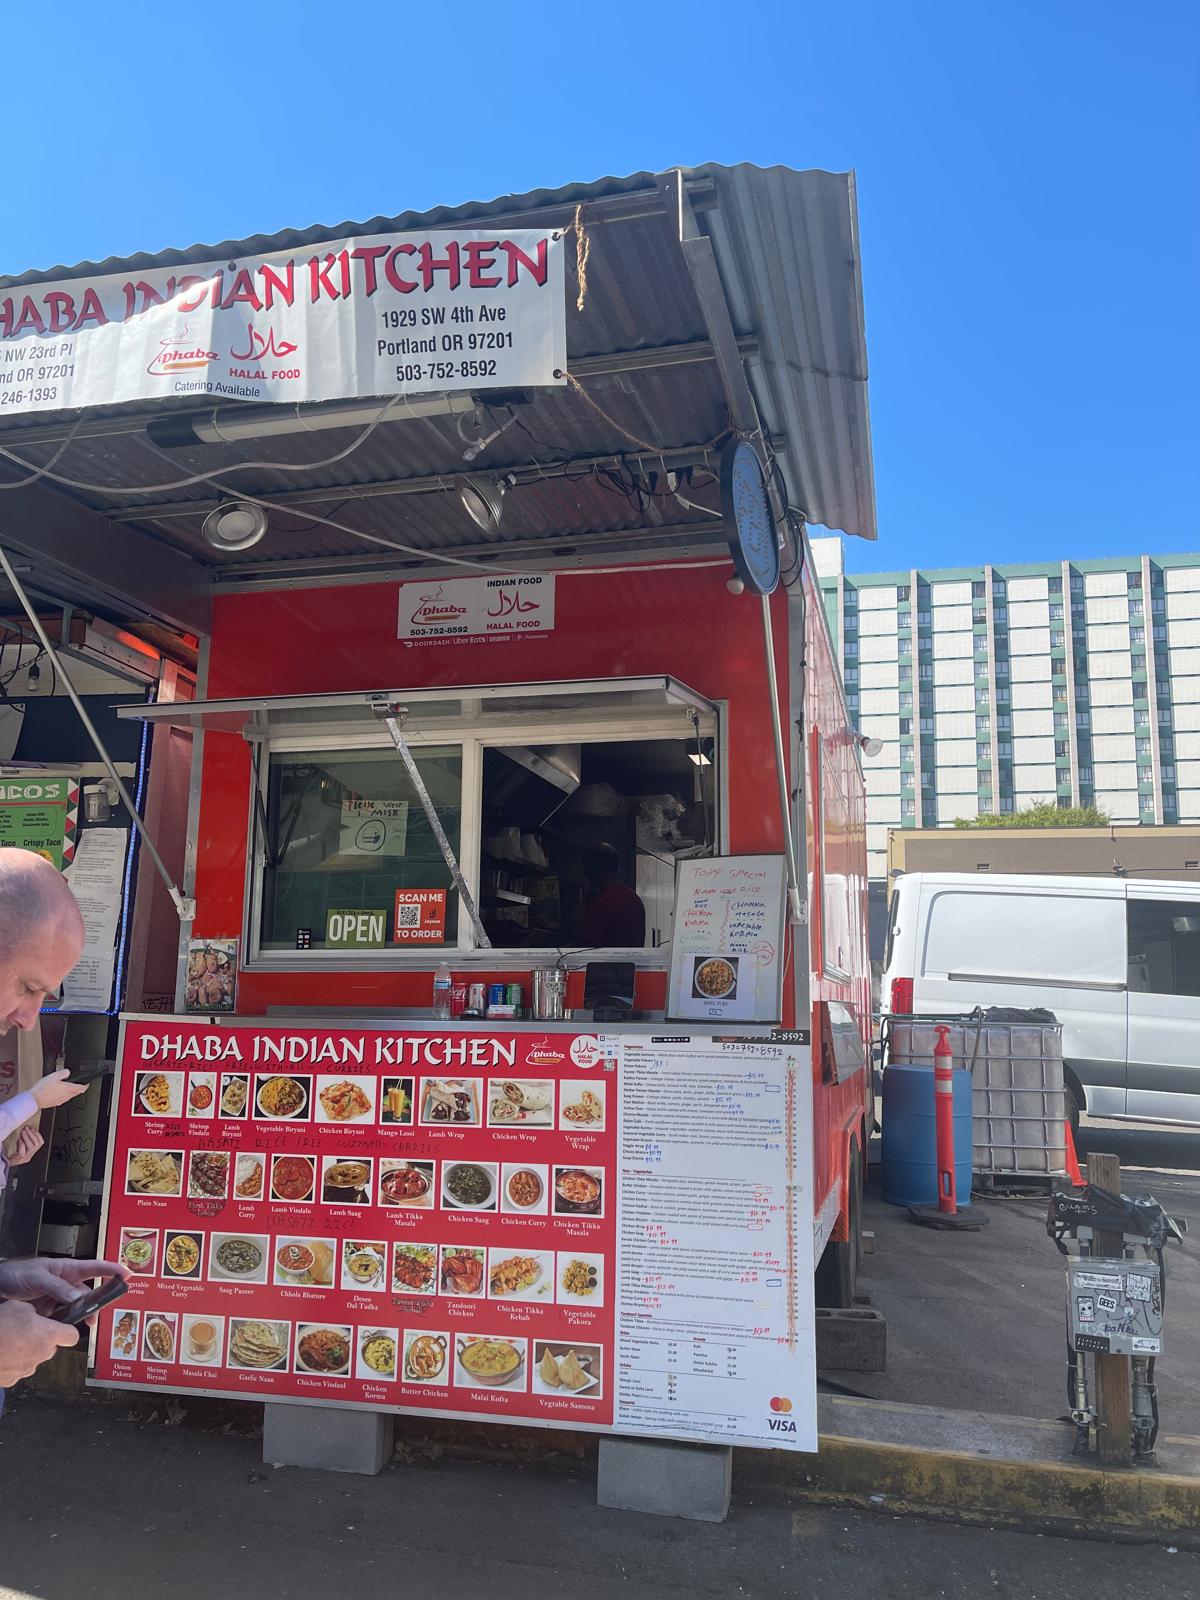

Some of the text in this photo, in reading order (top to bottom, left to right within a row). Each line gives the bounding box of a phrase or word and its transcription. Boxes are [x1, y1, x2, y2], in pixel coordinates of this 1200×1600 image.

[123, 260, 295, 324] INDIAN
[308, 238, 549, 304] KITCHEN
[382, 304, 506, 329] 1929 SW 4th Ave
[377, 331, 513, 357] Portland OR 97201
[5, 350, 27, 362] NW
[29, 346, 57, 360] 23rd
[160, 348, 220, 365] Dhaba
[16, 367, 34, 383] OR
[37, 363, 75, 381] 97201
[229, 367, 300, 380] HALAL FOOD
[396, 360, 497, 382] 503-752-8592
[174, 381, 260, 398] Catering Available
[487, 577, 542, 587] INDIAN FOOD
[422, 605, 468, 617] Dhaba
[486, 620, 541, 630] HALAL FOOD
[410, 626, 469, 636] 503-752-8592
[414, 639, 450, 647] DOORDASH
[453, 637, 470, 645] Uber
[23, 838, 45, 849] Crispy
[399, 893, 443, 902] SCAN ME
[329, 915, 383, 942] OPEN
[397, 930, 442, 938] TO ORDER
[139, 1034, 517, 1067] DHABA INDIAN KITCHEN
[532, 1050, 566, 1060] Dhaba
[145, 1121, 165, 1130] Shrimp
[189, 1123, 209, 1131] Shrimp
[256, 1125, 306, 1134] Vegetable Biryani
[147, 1128, 163, 1136] Curry
[222, 1130, 242, 1138] Biryani
[344, 1128, 365, 1136] Biryani
[377, 1129, 398, 1137] Mango
[446, 1132, 465, 1140] Wrap
[492, 1132, 537, 1142] Chicken Wrap
[564, 1135, 597, 1144] Vegetable
[571, 1142, 590, 1151] Wrap
[238, 1211, 255, 1219] Curry
[347, 1210, 361, 1218] Saag
[386, 1211, 423, 1220] Lamb Tikka
[394, 1218, 416, 1227] Masala
[448, 1215, 490, 1225] Chicken Saag
[501, 1217, 547, 1228] Chicken Curry
[553, 1221, 601, 1230] Chicken Tikka
[566, 1228, 590, 1236] Masala
[175, 1284, 204, 1293] Vegetable
[219, 1286, 255, 1296] Saag Paneer
[171, 1291, 188, 1299] Curry
[280, 1290, 326, 1300] Chhole Bhature
[358, 1303, 379, 1311] Tadka
[447, 1301, 477, 1310] Tandoori
[1100, 1297, 1115, 1309] GEES
[448, 1309, 474, 1318] Chicken
[497, 1304, 544, 1315] Chicken Tikka
[510, 1313, 531, 1321] Kebab
[563, 1310, 597, 1319] Vegetable
[568, 1317, 592, 1326] Pakora
[113, 1363, 132, 1371] Onion
[146, 1366, 168, 1375] Shrimp
[112, 1370, 132, 1378] Pakora
[146, 1373, 167, 1382] Biryani
[182, 1369, 218, 1378] Masala Chai
[238, 1374, 258, 1382] Garlic
[297, 1379, 321, 1387] Chicken
[362, 1384, 387, 1393] Chicken
[401, 1387, 448, 1397] Butter Chicken
[365, 1392, 386, 1400] Korma
[471, 1393, 509, 1403] Malai Kofta
[539, 1399, 595, 1411] Vegtable Samosa
[767, 1418, 797, 1433] VISA
